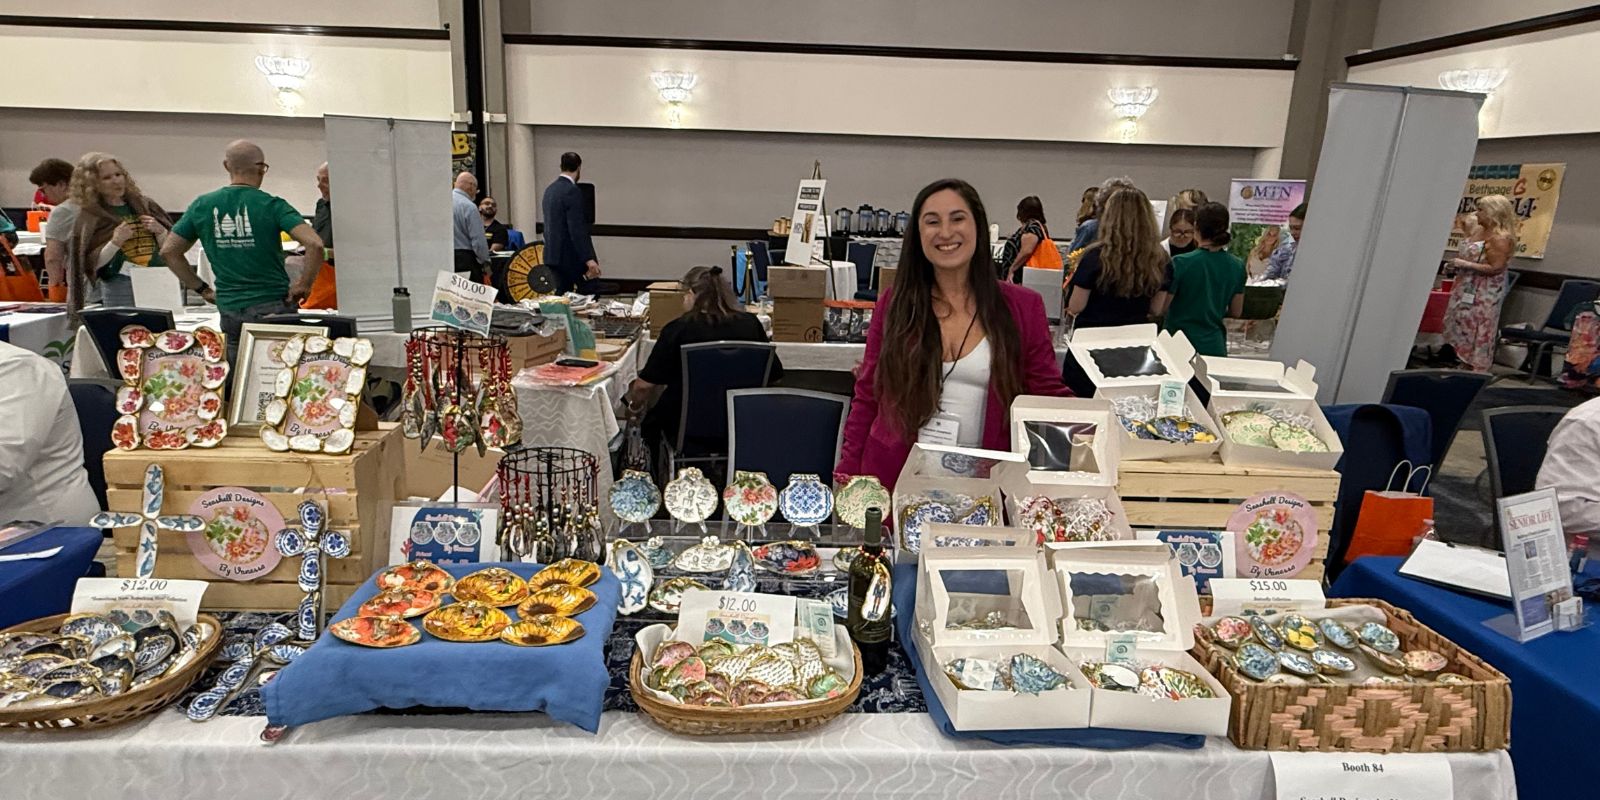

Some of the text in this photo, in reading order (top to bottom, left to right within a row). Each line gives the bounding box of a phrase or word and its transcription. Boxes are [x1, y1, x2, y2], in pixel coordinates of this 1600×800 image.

[1469, 184, 1512, 195] Bethpage
[451, 275, 486, 295] $10.00
[201, 493, 264, 509] Seashell Designs
[1245, 496, 1304, 512] Seashell Designs
[1508, 510, 1553, 530] SENIOR LIFE
[219, 563, 266, 576] By Vanessa
[1250, 564, 1296, 578] By Vanessa
[120, 579, 168, 592] $12.00
[1250, 580, 1287, 592] $15.00
[718, 595, 757, 612] $12.00
[1342, 762, 1385, 773] Booth 84
